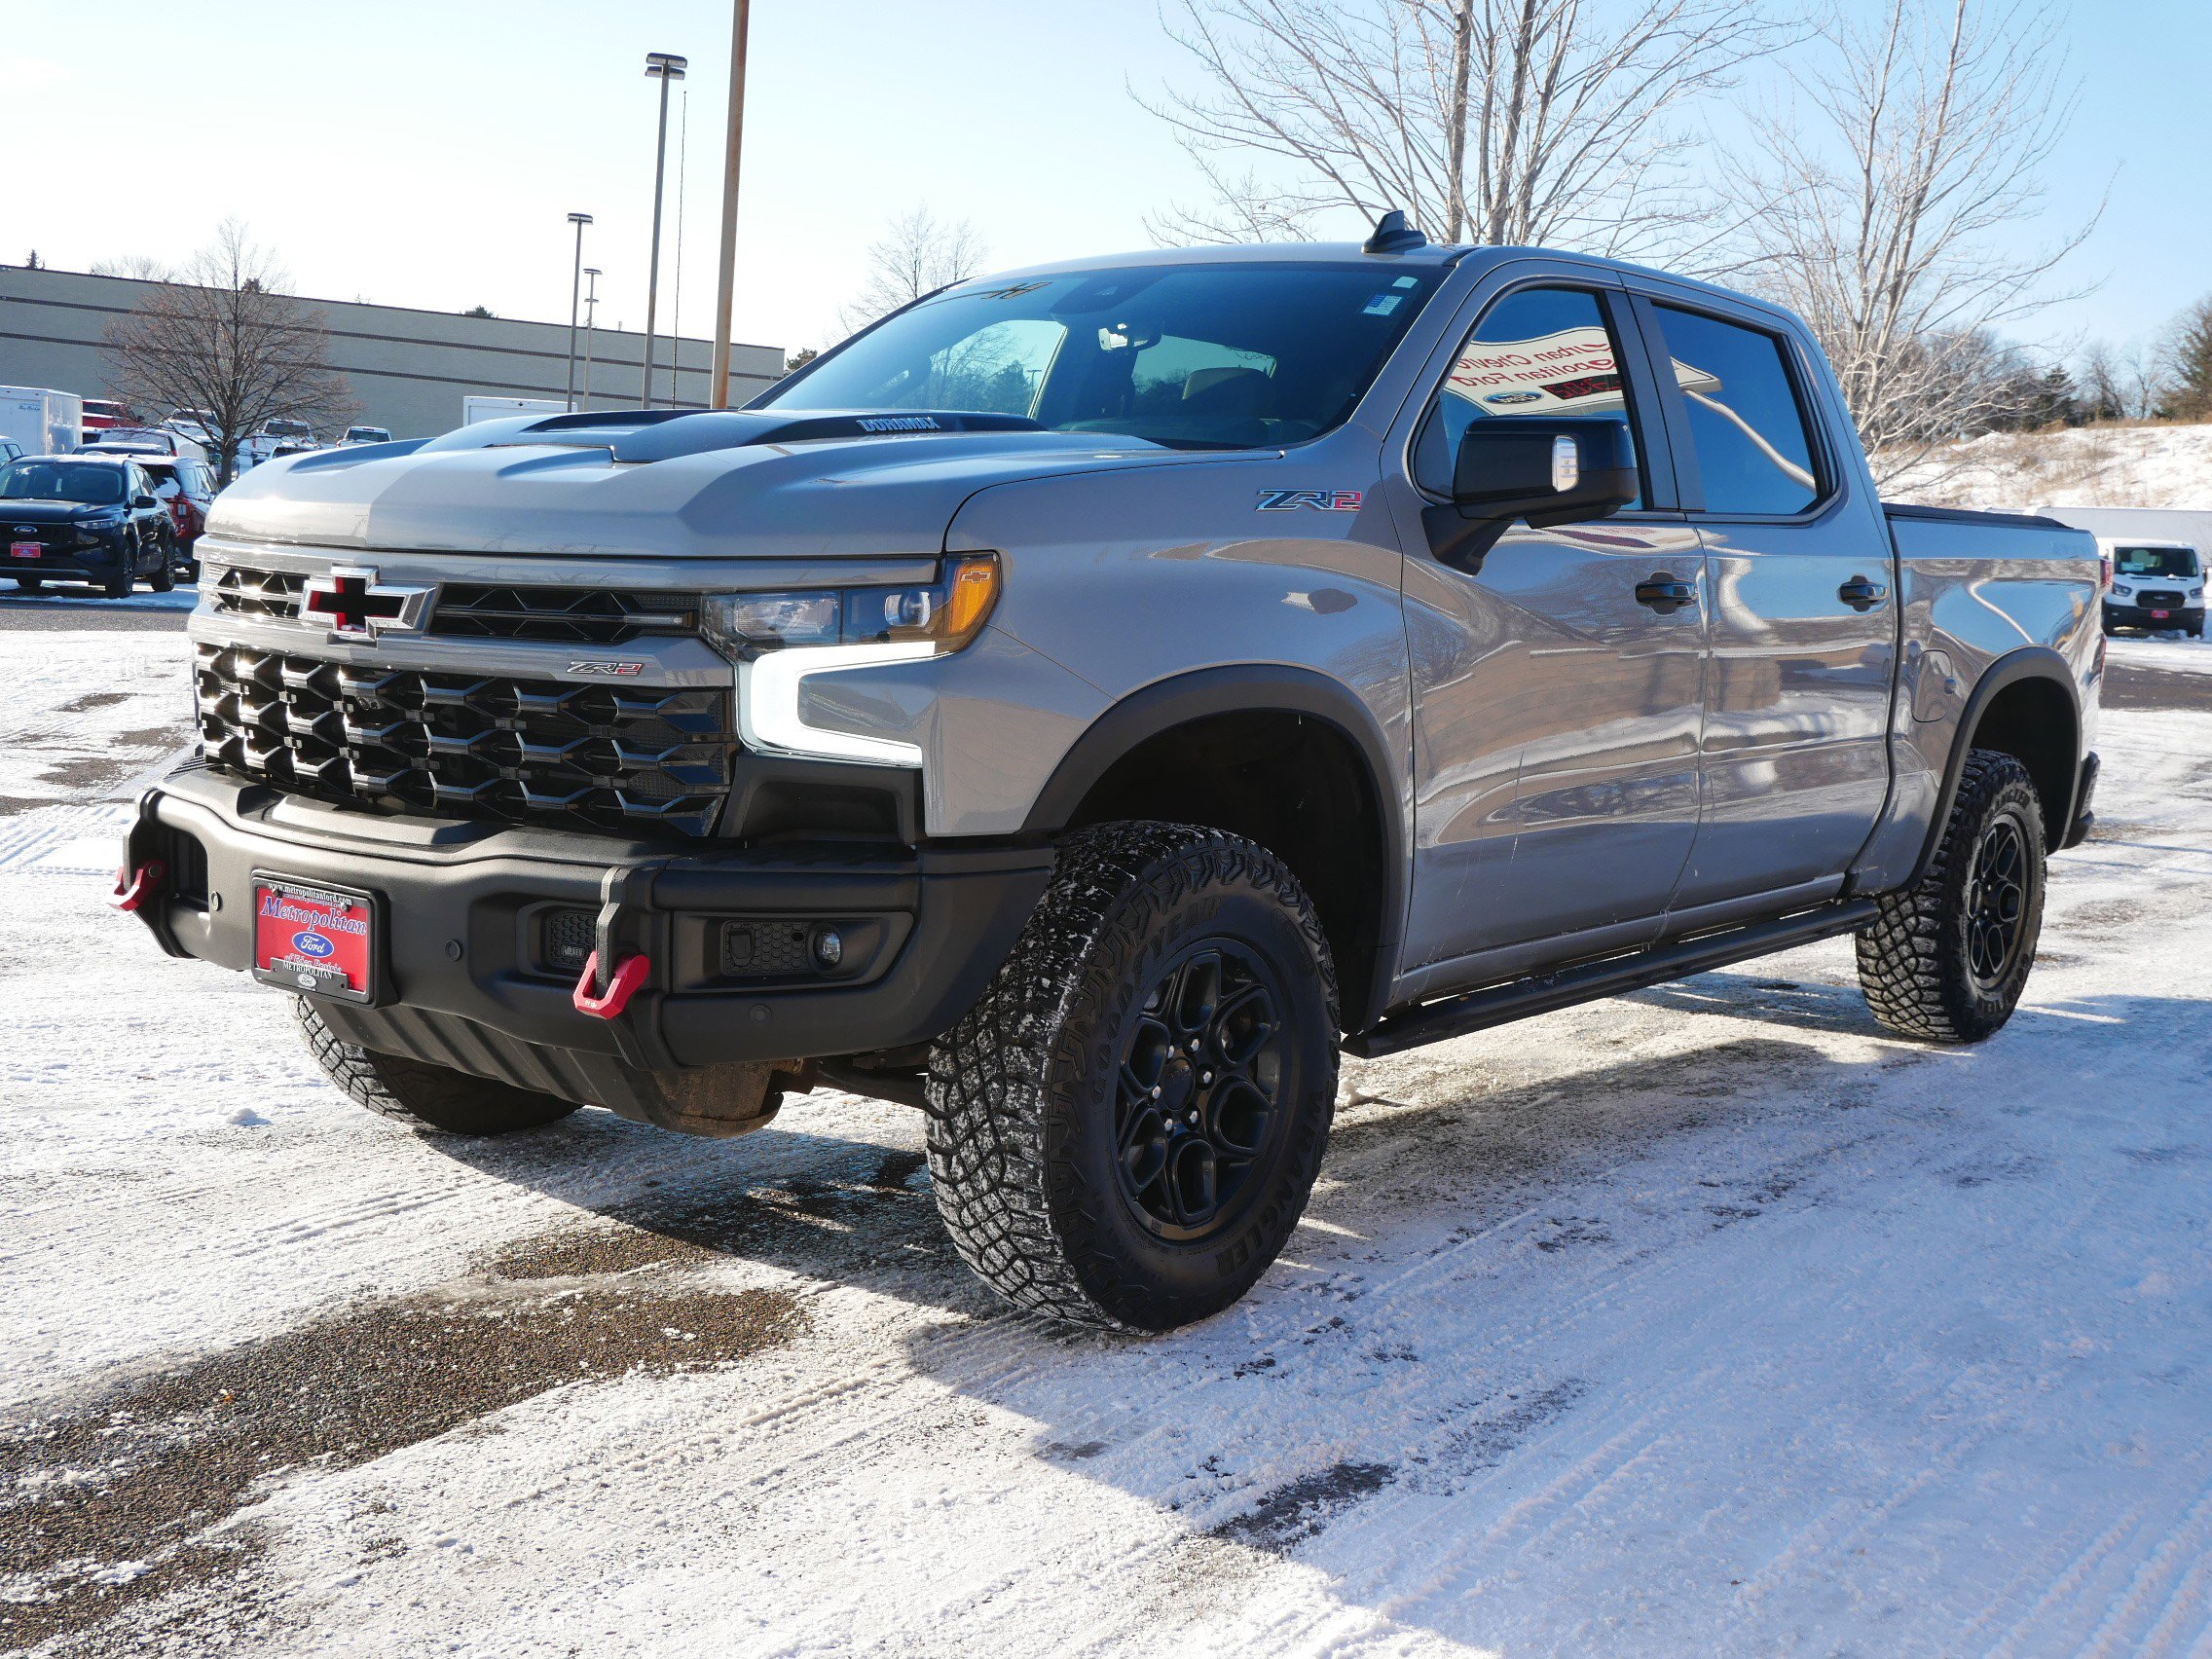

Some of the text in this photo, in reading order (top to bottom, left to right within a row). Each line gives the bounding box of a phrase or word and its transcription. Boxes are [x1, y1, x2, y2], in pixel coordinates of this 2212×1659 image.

[856, 417, 941, 432] DURAMAX
[1256, 489, 1361, 512] ZR2
[566, 661, 644, 676] ZR2
[269, 882, 352, 905] www.metropolitanford.com
[261, 896, 367, 936] Metropolitan
[300, 935, 326, 953] Ford
[283, 961, 332, 979] METROPOLITAN
